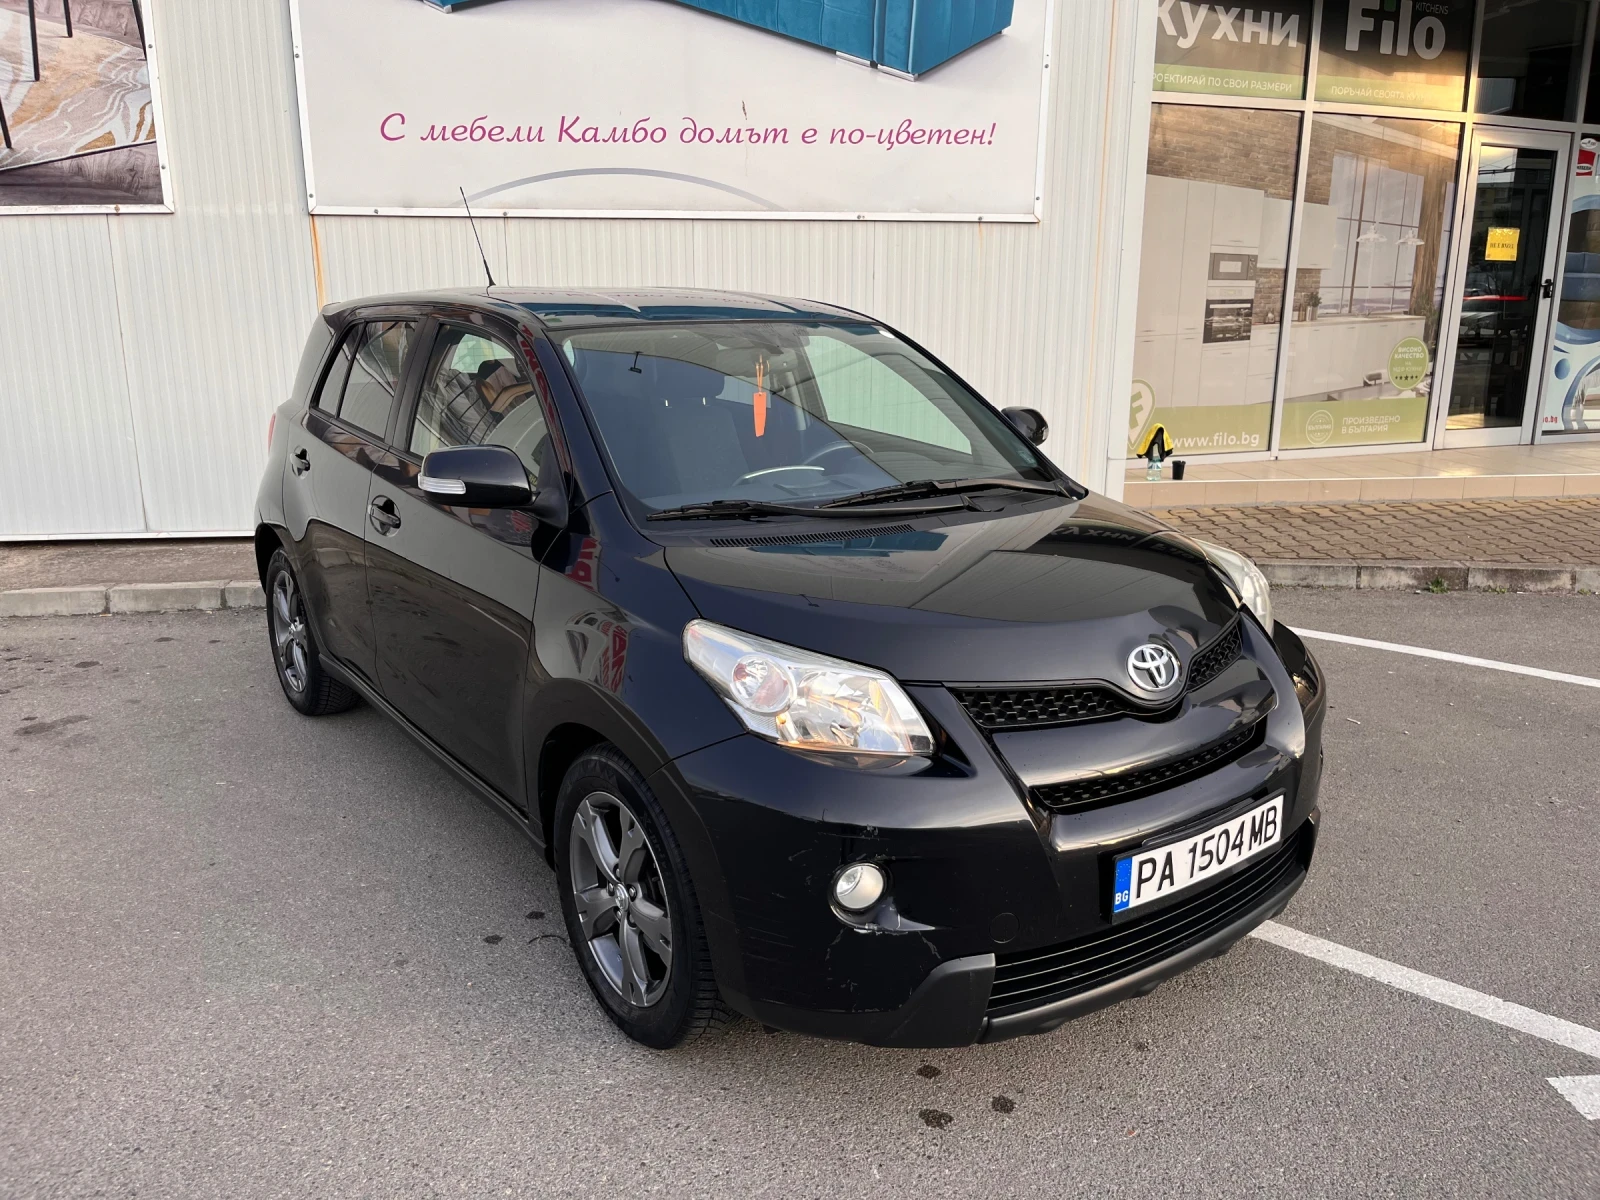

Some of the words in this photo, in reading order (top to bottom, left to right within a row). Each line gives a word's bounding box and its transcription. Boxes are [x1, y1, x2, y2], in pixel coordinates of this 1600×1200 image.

[1415, 2, 1449, 14] KITCHENS
[1345, 0, 1446, 60] Filo
[1152, 72, 1206, 86] РОЕКТИРАЙ
[1208, 77, 1221, 87] ПО
[1223, 78, 1249, 88] СВОИ
[1250, 81, 1292, 92] РАЗМЕРИ
[1331, 85, 1372, 97] ПОРЪЧАЙ
[1373, 89, 1405, 99] СВОЯТА
[380, 113, 406, 142] С
[421, 116, 544, 143] мебели
[558, 116, 668, 144] Камбо
[680, 117, 789, 145] домът
[801, 128, 818, 145] е
[830, 119, 997, 150] по-цветен!
[1342, 415, 1401, 425] ПРОИЗВЕДЕНО
[1542, 415, 1558, 424] o.bg
[1341, 426, 1347, 434] В
[1348, 424, 1389, 434] БЪЛГАРИЯ
[1172, 432, 1260, 448] www.filo.bg
[1136, 851, 1175, 900] PA
[1188, 820, 1246, 879] 1504
[1250, 805, 1278, 852] MB
[1115, 890, 1129, 905] BG
